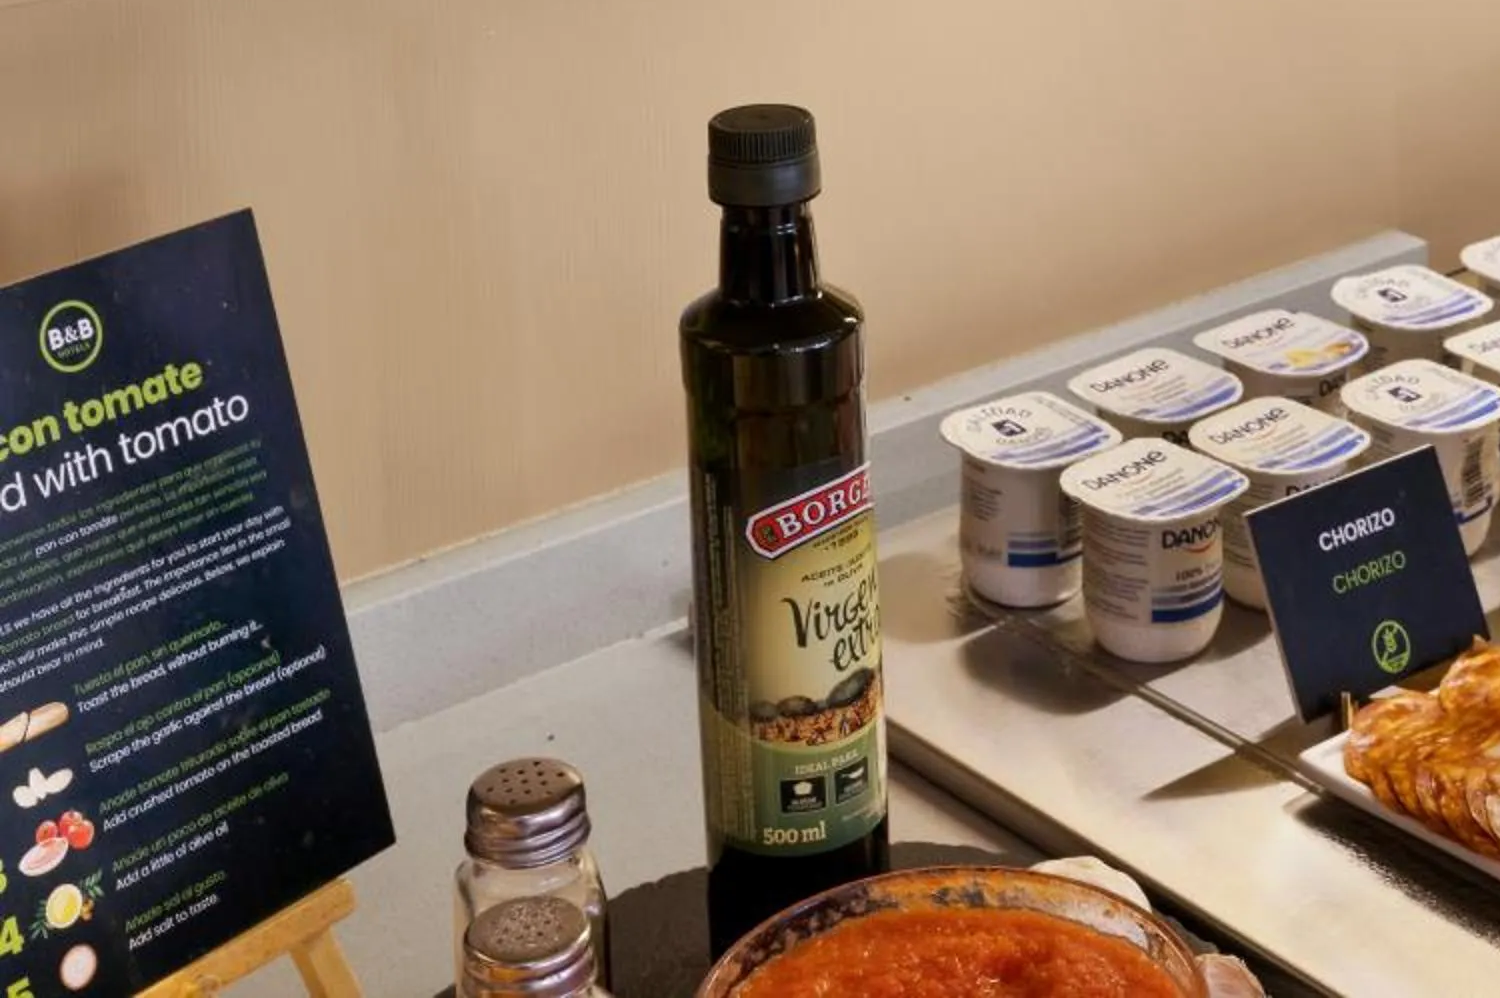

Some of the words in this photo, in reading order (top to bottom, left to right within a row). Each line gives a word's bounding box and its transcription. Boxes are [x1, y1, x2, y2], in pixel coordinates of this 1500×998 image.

[47, 318, 93, 350] B&B
[63, 363, 201, 431] tomate
[1089, 358, 1170, 394] DANONE
[33, 444, 112, 497] with
[118, 395, 248, 463] tomato
[1209, 407, 1290, 446] DANONE
[1082, 450, 1168, 491] DANONE
[57, 531, 79, 545] con
[1318, 507, 1396, 552] CHORIZO
[30, 603, 59, 621] have
[73, 588, 93, 603] the
[92, 563, 150, 594] ingredients
[150, 556, 165, 569] for
[166, 548, 186, 565] you
[185, 542, 198, 554] to
[197, 531, 221, 549] start
[221, 523, 243, 540] your
[243, 514, 263, 529] day
[74, 606, 90, 620] for
[143, 575, 162, 590] The
[162, 550, 219, 581] importance
[247, 530, 264, 544] the
[264, 517, 291, 536] small
[1332, 551, 1407, 594] CHORIZO
[35, 636, 67, 656] make
[67, 627, 88, 642] this
[89, 610, 124, 632] simple
[124, 595, 157, 616] recipe
[781, 567, 877, 648] Virgen
[35, 656, 61, 675] bear
[62, 651, 75, 662] in
[77, 690, 109, 713] Toast
[108, 682, 129, 698] the
[166, 644, 207, 670] without
[206, 625, 249, 651] burning
[89, 745, 130, 772] Scrape
[130, 735, 151, 751] the
[150, 719, 182, 744] garlic
[183, 697, 224, 725] against
[224, 689, 243, 705] the
[243, 671, 276, 695] bread
[276, 646, 326, 680] (optional)
[102, 809, 127, 831] Add
[127, 785, 174, 818] crushed
[174, 766, 215, 793] tomato
[215, 758, 231, 772] on
[231, 748, 250, 764] the
[250, 725, 291, 754] toasted
[763, 826, 799, 845] 500
[801, 819, 827, 843] ml
[115, 869, 140, 890] Add
[139, 865, 150, 877] a
[174, 842, 187, 858] of
[187, 830, 214, 851] olive
[0, 915, 24, 955] 4
[128, 927, 153, 950] Add
[152, 916, 174, 936] salt
[174, 909, 189, 923] to
